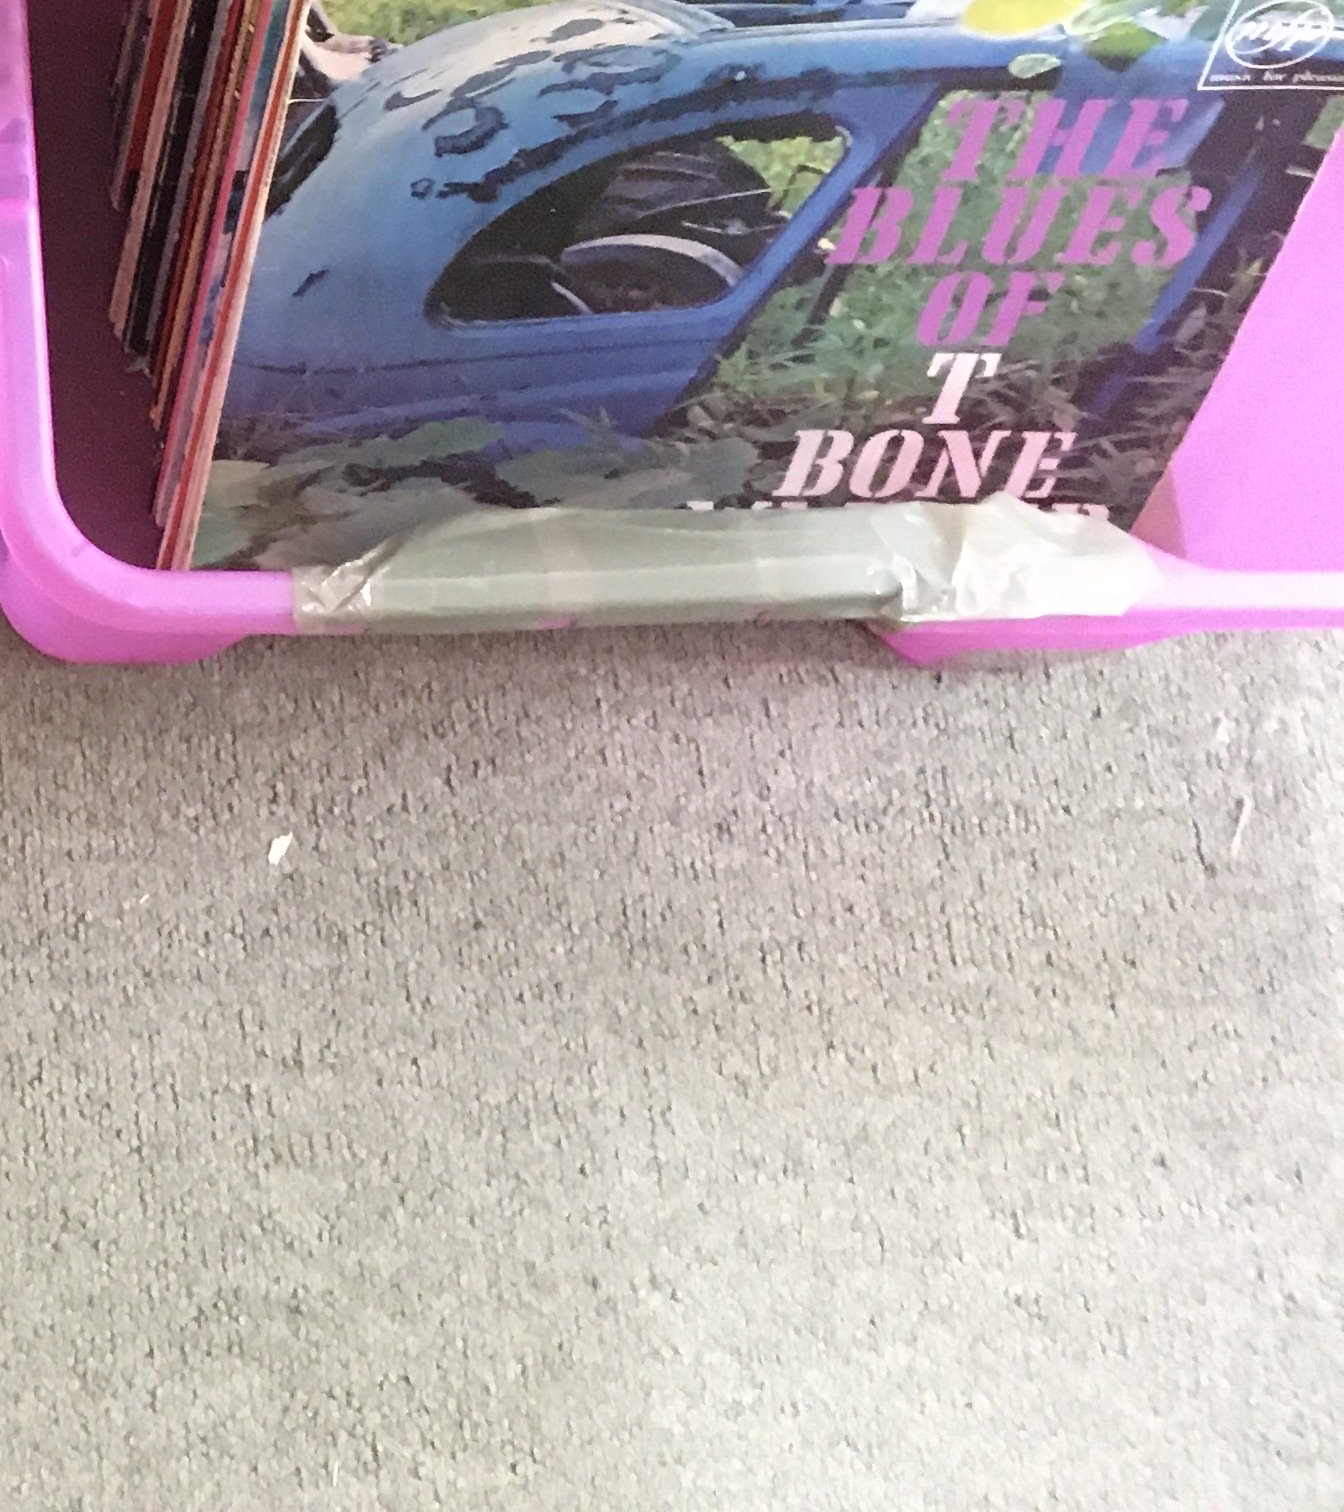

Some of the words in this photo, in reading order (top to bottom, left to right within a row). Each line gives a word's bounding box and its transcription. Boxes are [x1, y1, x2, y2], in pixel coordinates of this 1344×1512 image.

[939, 98, 1189, 181] THE
[827, 186, 1213, 267] BLUES
[916, 271, 1065, 347] OF
[922, 352, 1003, 425] T
[771, 428, 1078, 499] BONE
